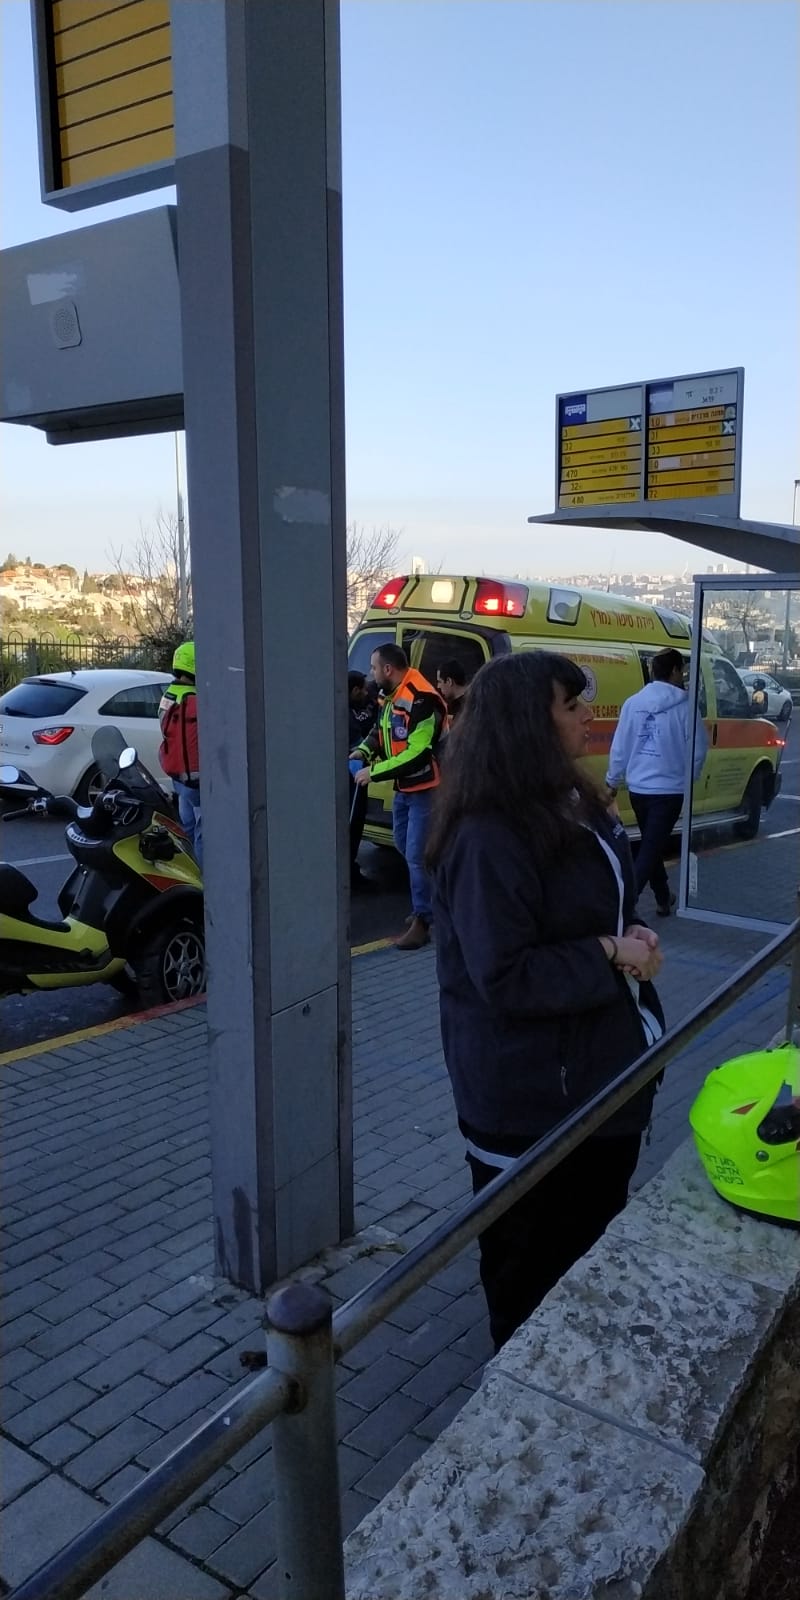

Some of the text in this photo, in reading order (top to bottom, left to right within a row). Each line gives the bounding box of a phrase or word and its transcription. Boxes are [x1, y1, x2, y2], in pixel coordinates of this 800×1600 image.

[652, 446, 660, 455] 33
[566, 469, 578, 478] 470
[590, 609, 611, 628] נמרץ
[602, 705, 618, 718] CARE
